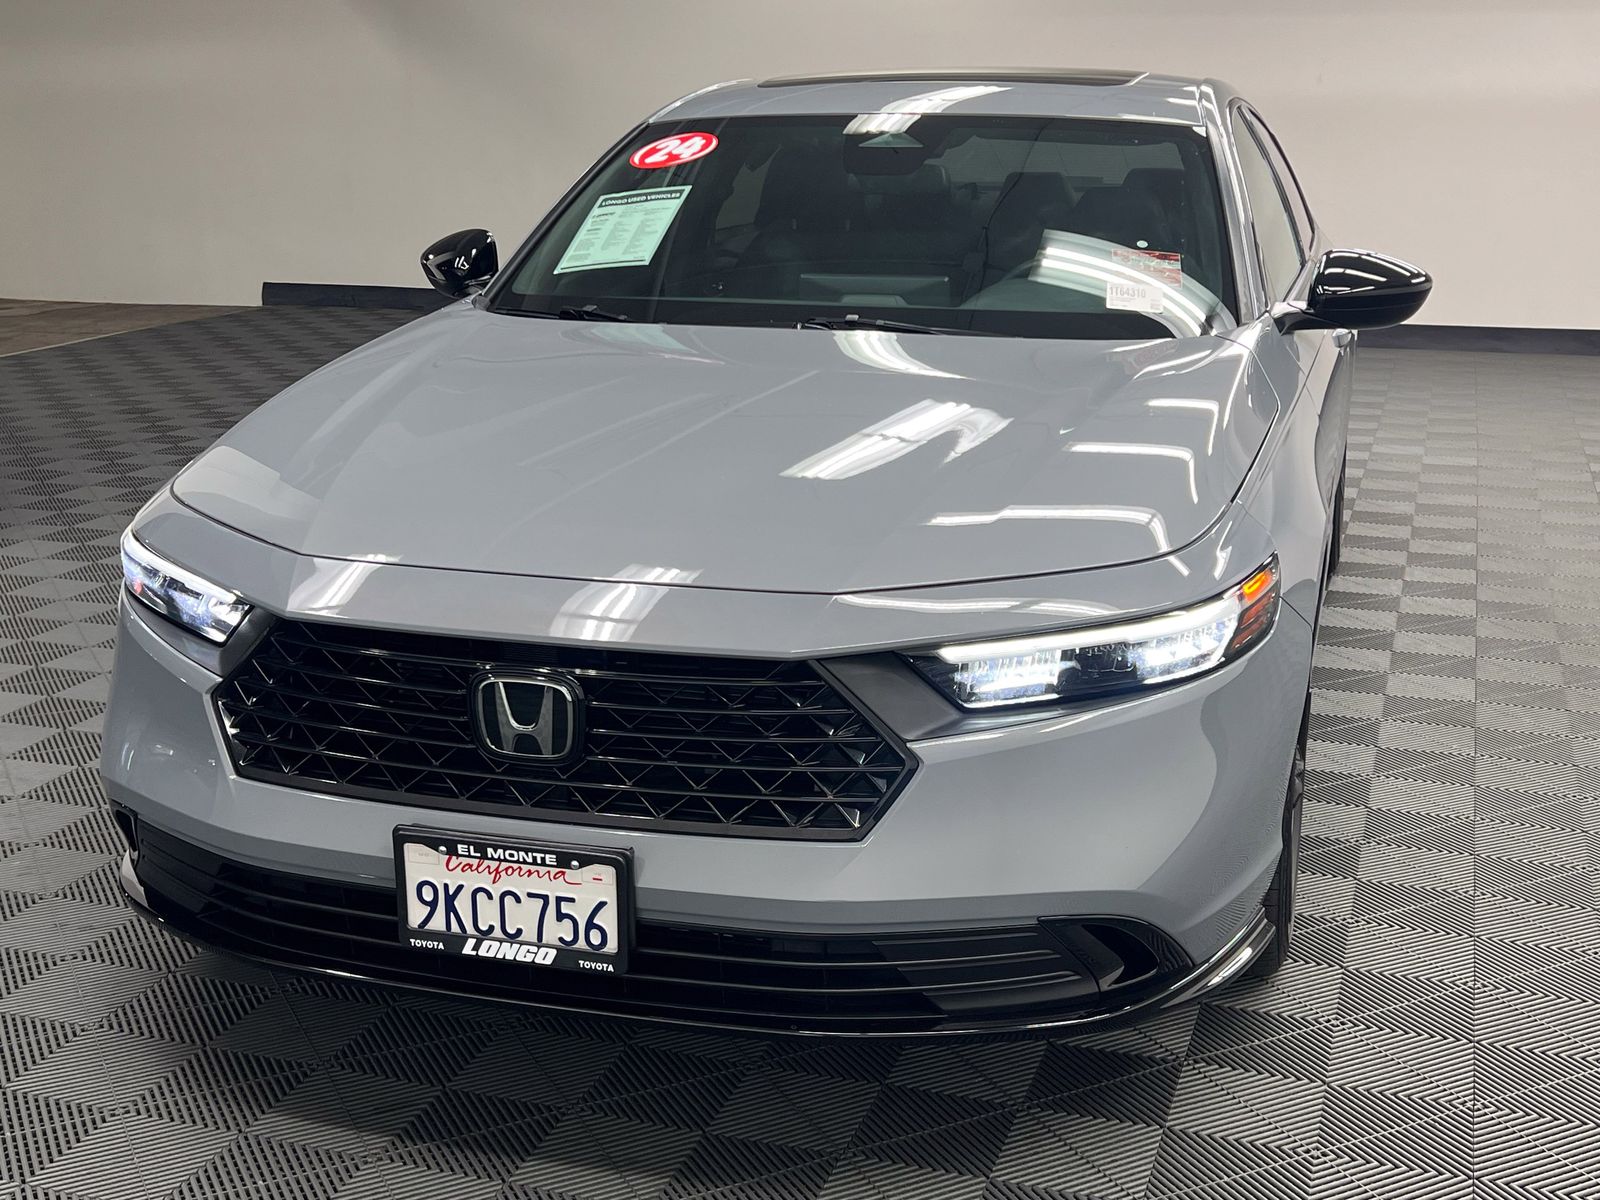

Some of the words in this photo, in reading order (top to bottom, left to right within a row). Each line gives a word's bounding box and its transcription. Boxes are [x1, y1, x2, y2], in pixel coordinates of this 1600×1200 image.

[644, 136, 707, 165] 24
[601, 197, 628, 207] LONGO
[628, 195, 647, 203] USED
[647, 192, 681, 201] VEHICLES
[1109, 286, 1147, 298] 1T64310
[456, 843, 481, 858] EL
[486, 847, 558, 866] MONTE
[444, 854, 584, 885] California
[415, 879, 609, 951] 9KCC756
[409, 938, 445, 950] TOYOTA
[461, 937, 558, 965] LONGO
[578, 960, 615, 972] TOYOTA
